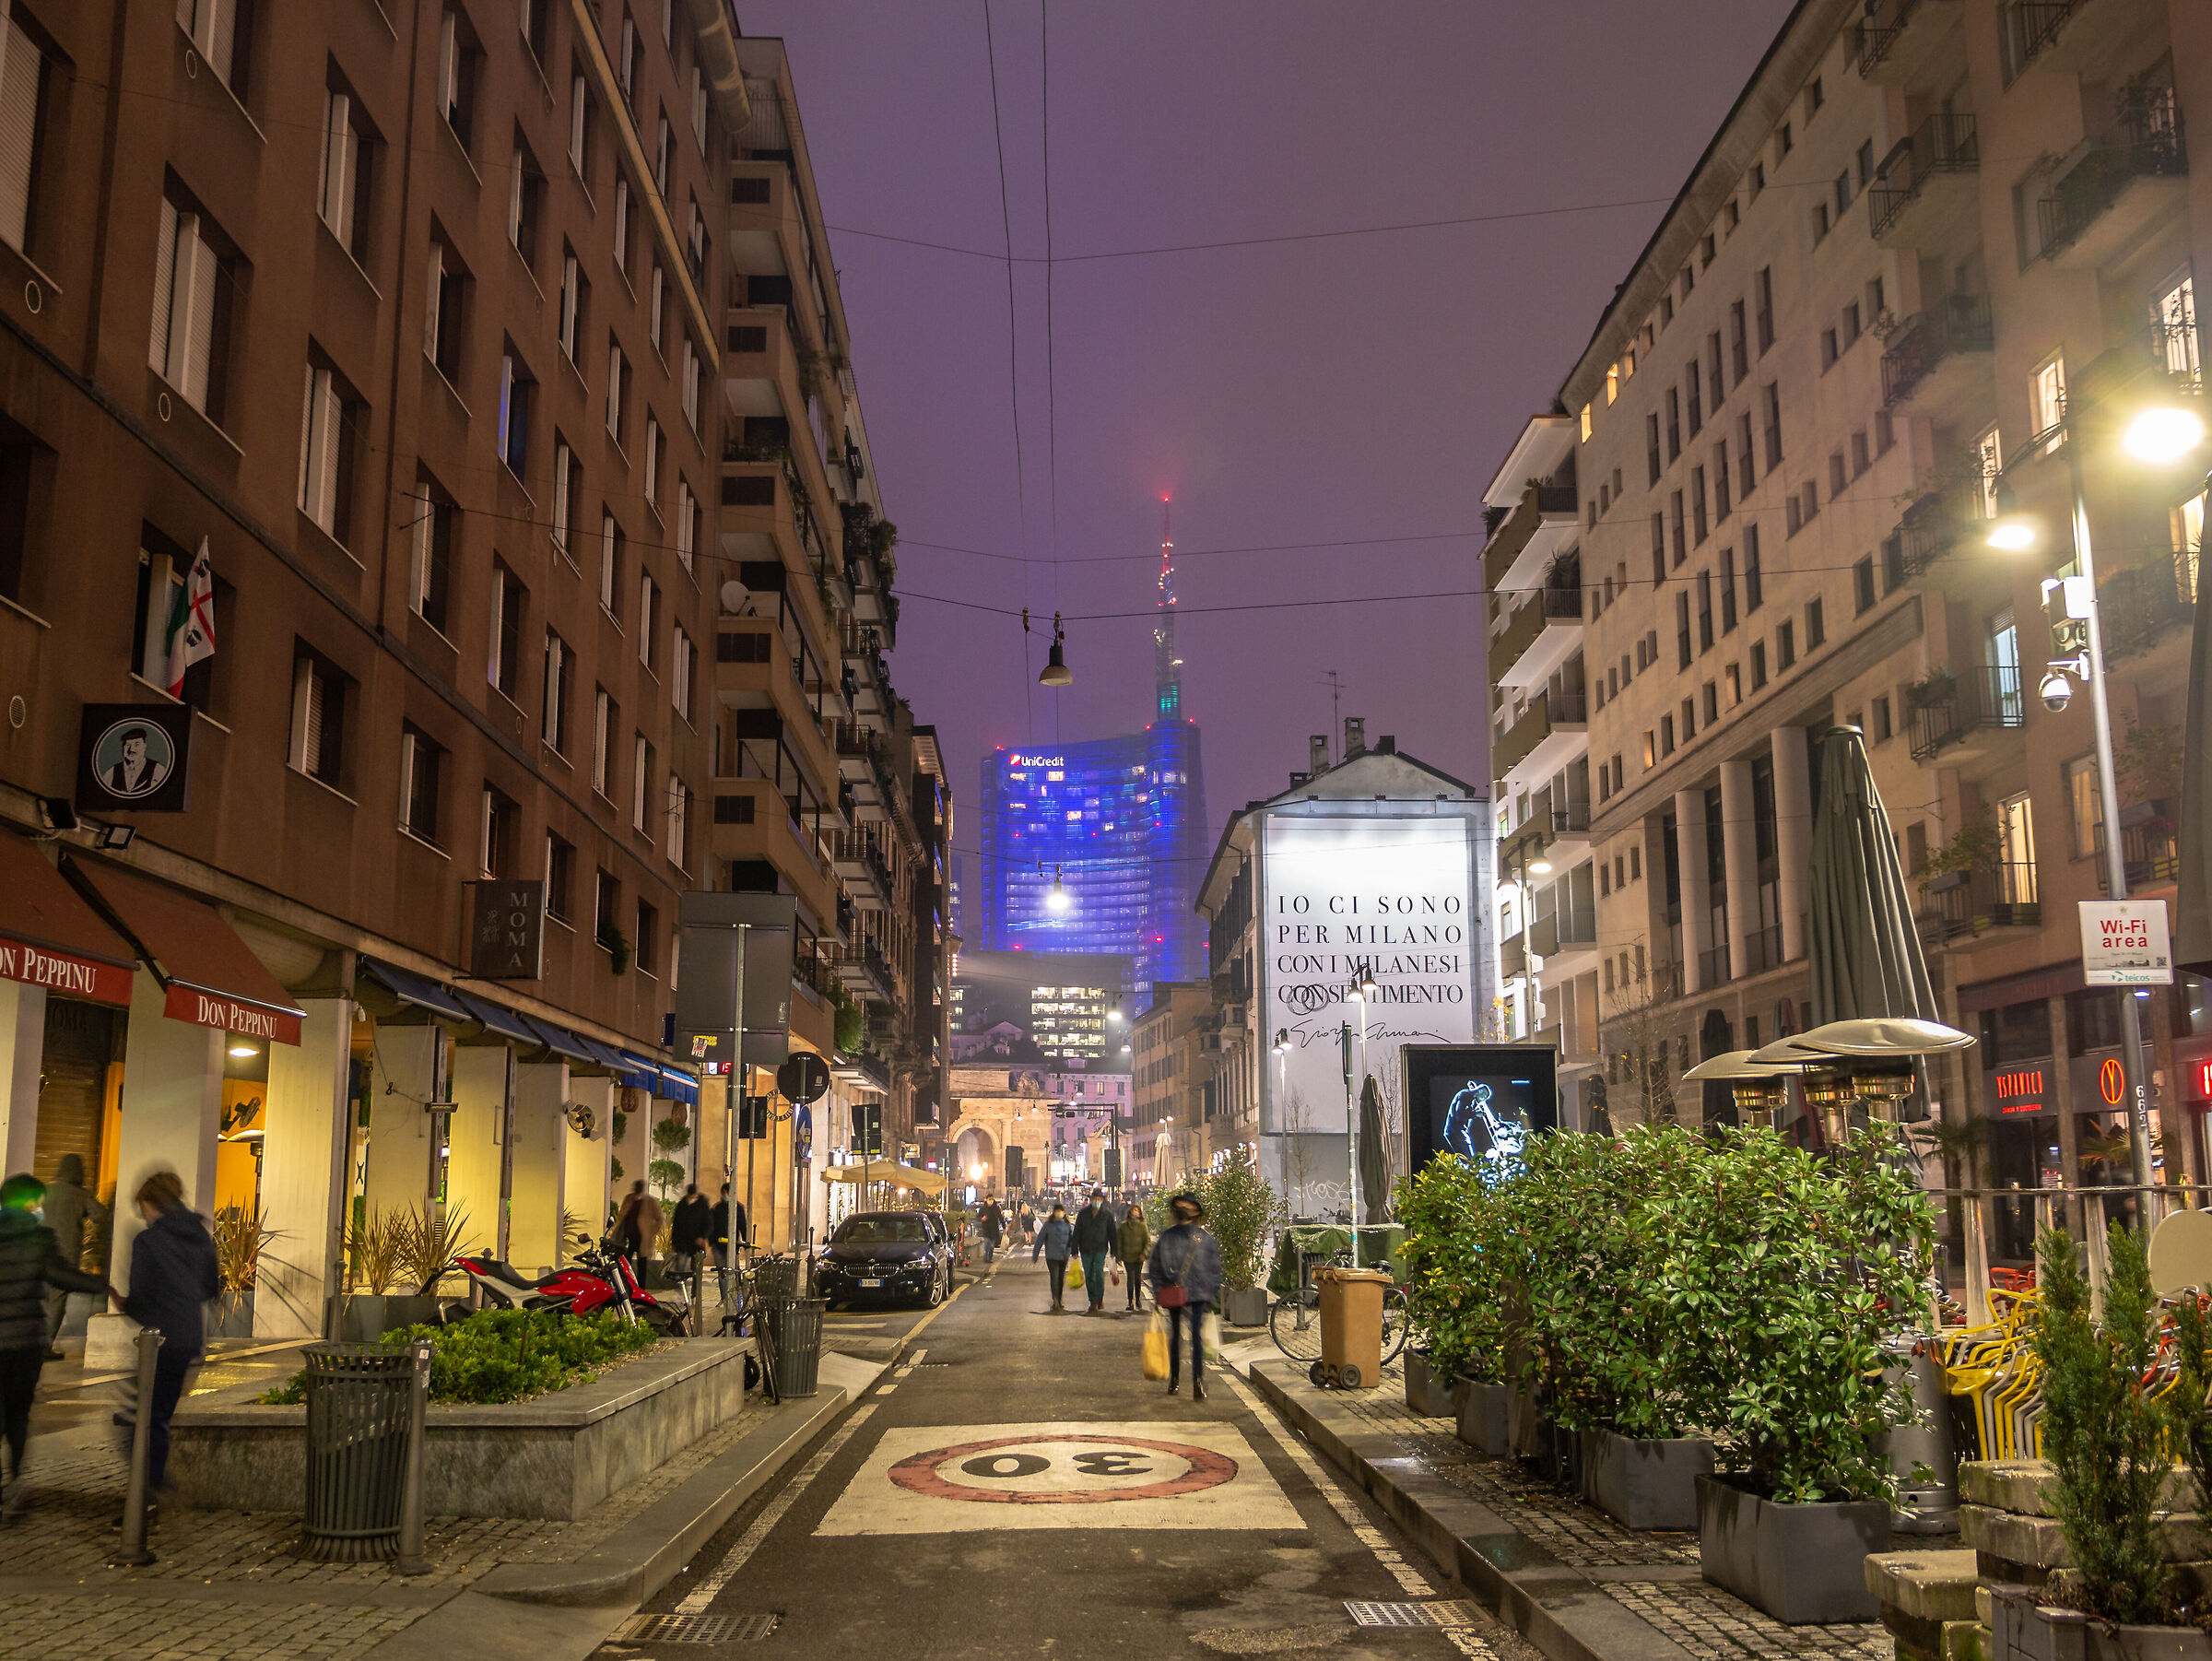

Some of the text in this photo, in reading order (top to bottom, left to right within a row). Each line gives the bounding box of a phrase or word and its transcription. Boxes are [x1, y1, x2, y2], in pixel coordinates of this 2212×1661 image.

[1021, 756, 1064, 766] UniCredit
[1278, 896, 1461, 914] IO CI SONO
[509, 891, 528, 967] MOMA
[1278, 925, 1462, 944] PER MILANO
[2100, 919, 2147, 935] Wi-Fi
[2102, 937, 2148, 948] area
[22, 947, 97, 995] PEPPINU
[1277, 955, 1324, 973] CON
[1345, 955, 1460, 973] MILANESI
[197, 995, 277, 1039] DON PEPPINU
[960, 1451, 1154, 1478] 30
